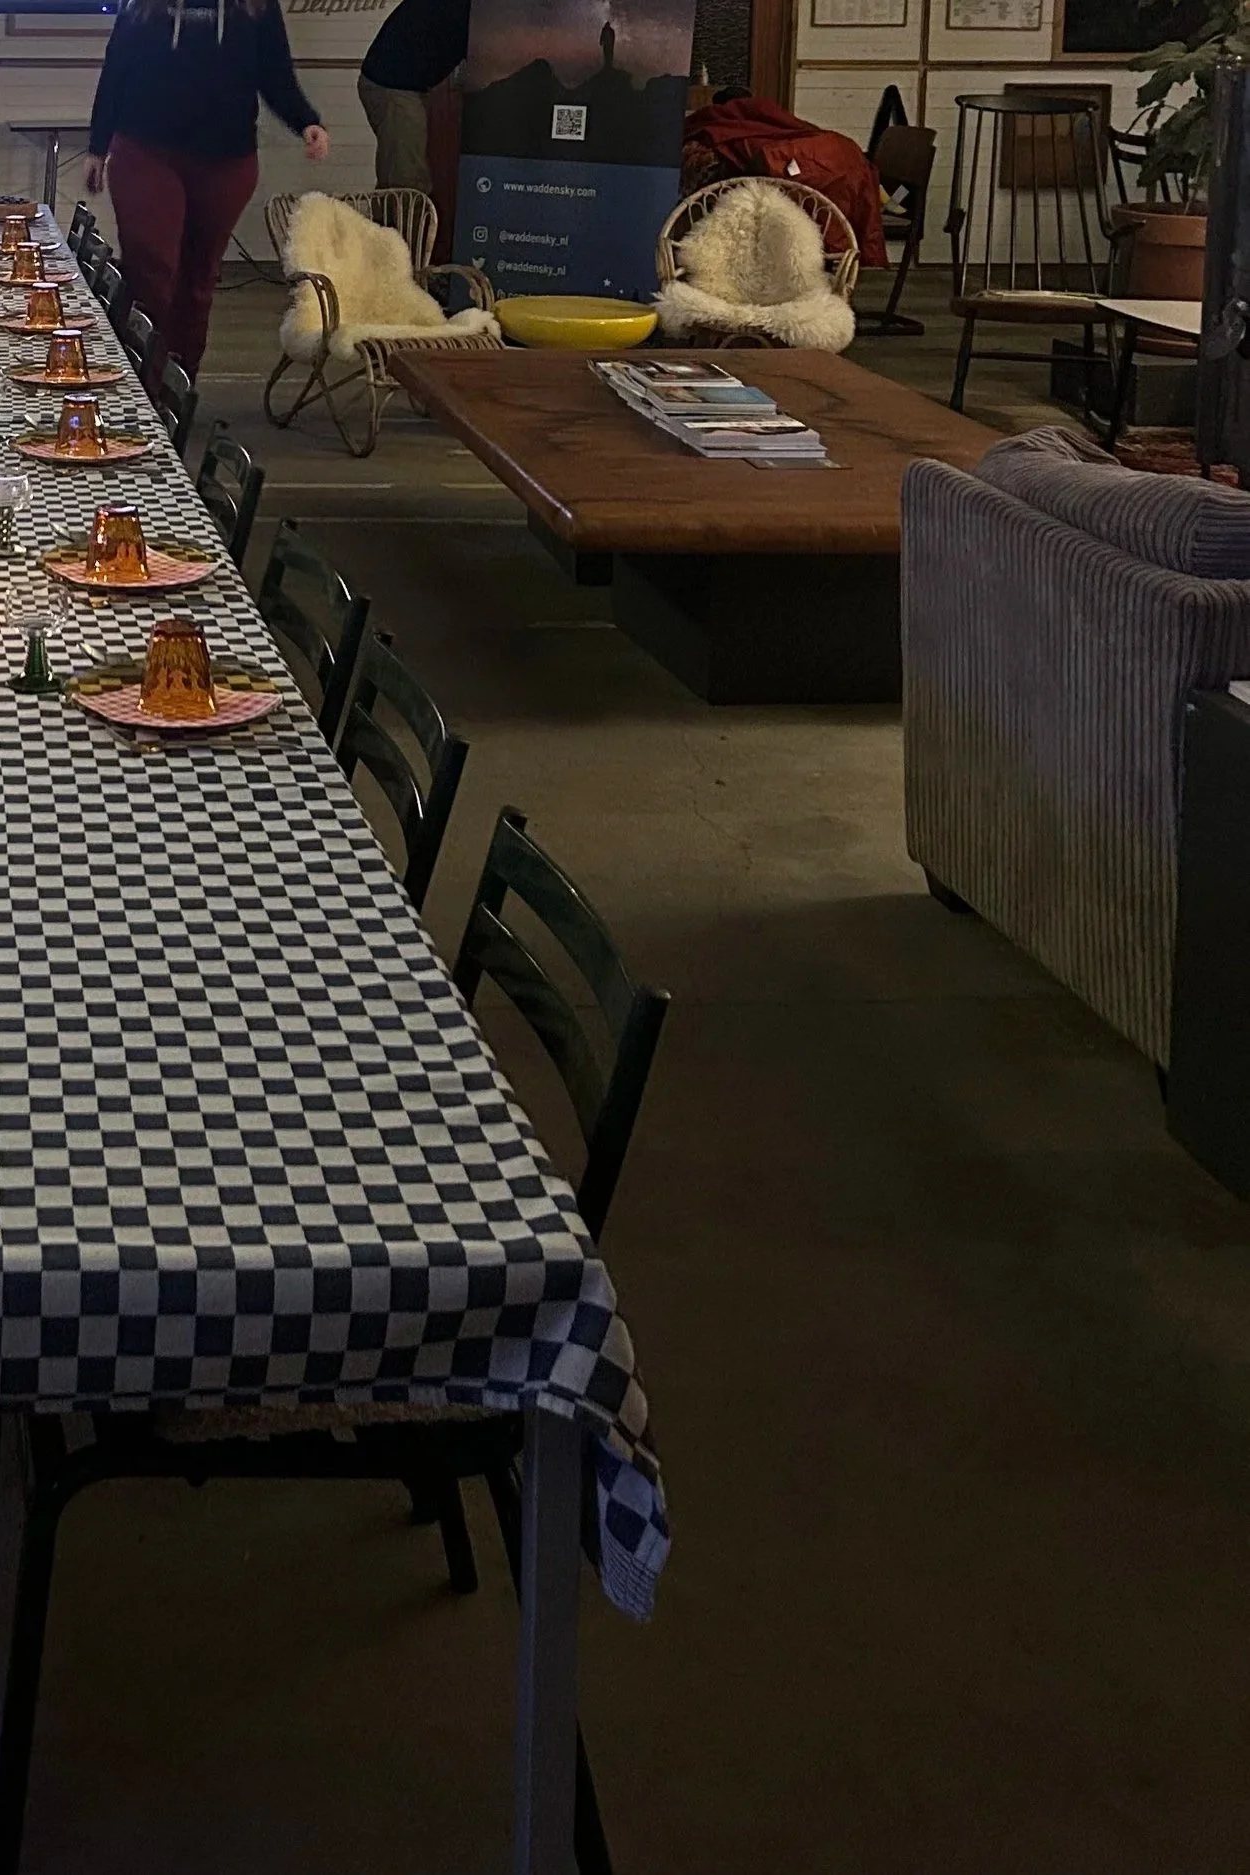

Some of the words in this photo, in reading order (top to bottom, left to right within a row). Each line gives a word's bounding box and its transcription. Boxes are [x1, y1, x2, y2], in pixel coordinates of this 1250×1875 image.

[503, 182, 597, 198] www.waddensky.com
[499, 230, 569, 247] @waddensky_nl
[497, 260, 566, 277] @waddensky_nl
